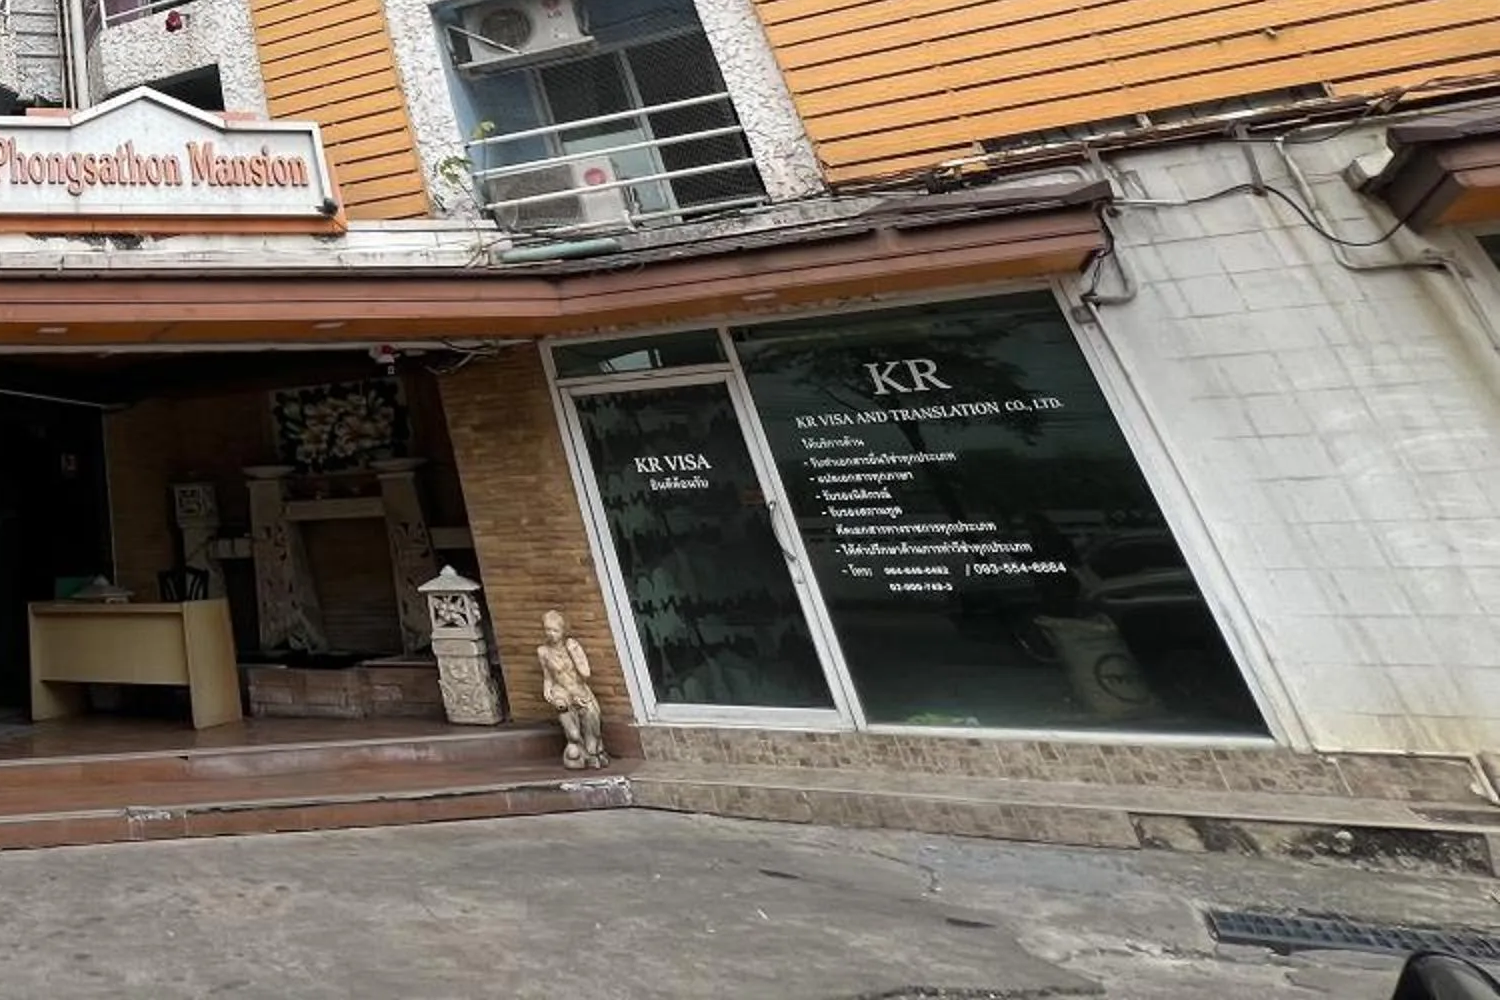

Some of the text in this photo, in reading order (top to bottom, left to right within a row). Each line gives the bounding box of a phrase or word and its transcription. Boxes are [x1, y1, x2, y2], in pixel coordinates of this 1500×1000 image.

[185, 140, 310, 188] Mansion
[863, 358, 953, 396] KR
[795, 415, 818, 429] KR
[818, 412, 854, 427] VISA
[856, 409, 887, 424] AND
[891, 401, 1000, 422] TRANSLATION
[1033, 396, 1064, 410] LTD.
[634, 453, 713, 473] KR VISA
